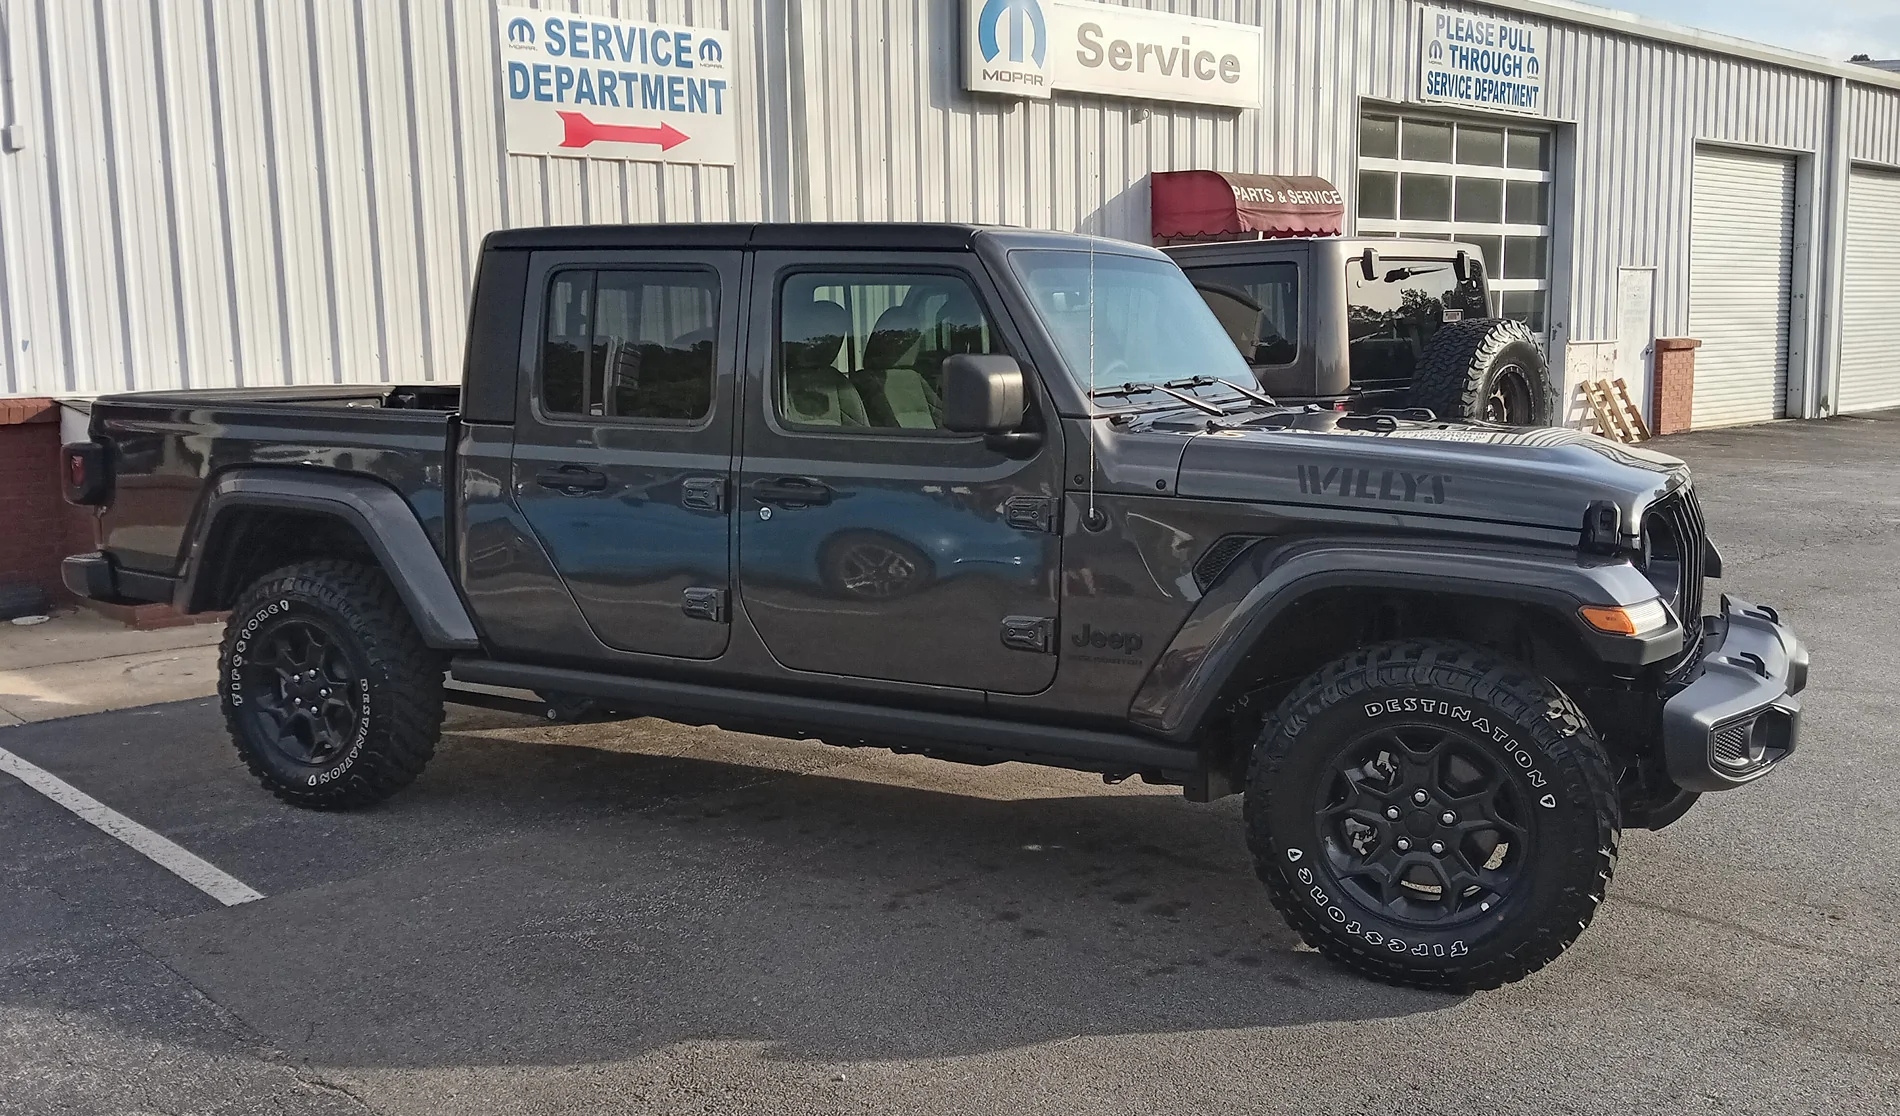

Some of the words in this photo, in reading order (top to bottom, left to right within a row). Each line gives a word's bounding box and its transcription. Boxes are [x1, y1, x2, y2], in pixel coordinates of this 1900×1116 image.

[544, 17, 694, 69] SERVICE
[1076, 22, 1241, 83] Service
[1436, 14, 1495, 47] PLEASE
[1500, 25, 1535, 53] PULL
[983, 69, 1043, 86] MOPAR
[1449, 44, 1523, 78] THROUGH
[508, 60, 726, 115] DEPARTMENT
[1427, 71, 1472, 99] SERVICE
[1474, 76, 1539, 108] DEPARTMENT
[1231, 186, 1275, 203] PARTS
[1277, 190, 1287, 203] &
[1287, 189, 1343, 204] SERVICE
[1297, 464, 1452, 504] WILLYS
[1071, 623, 1143, 655] Jeep
[319, 679, 371, 785] DESTINATION
[1364, 698, 1547, 788] DESTINATION
